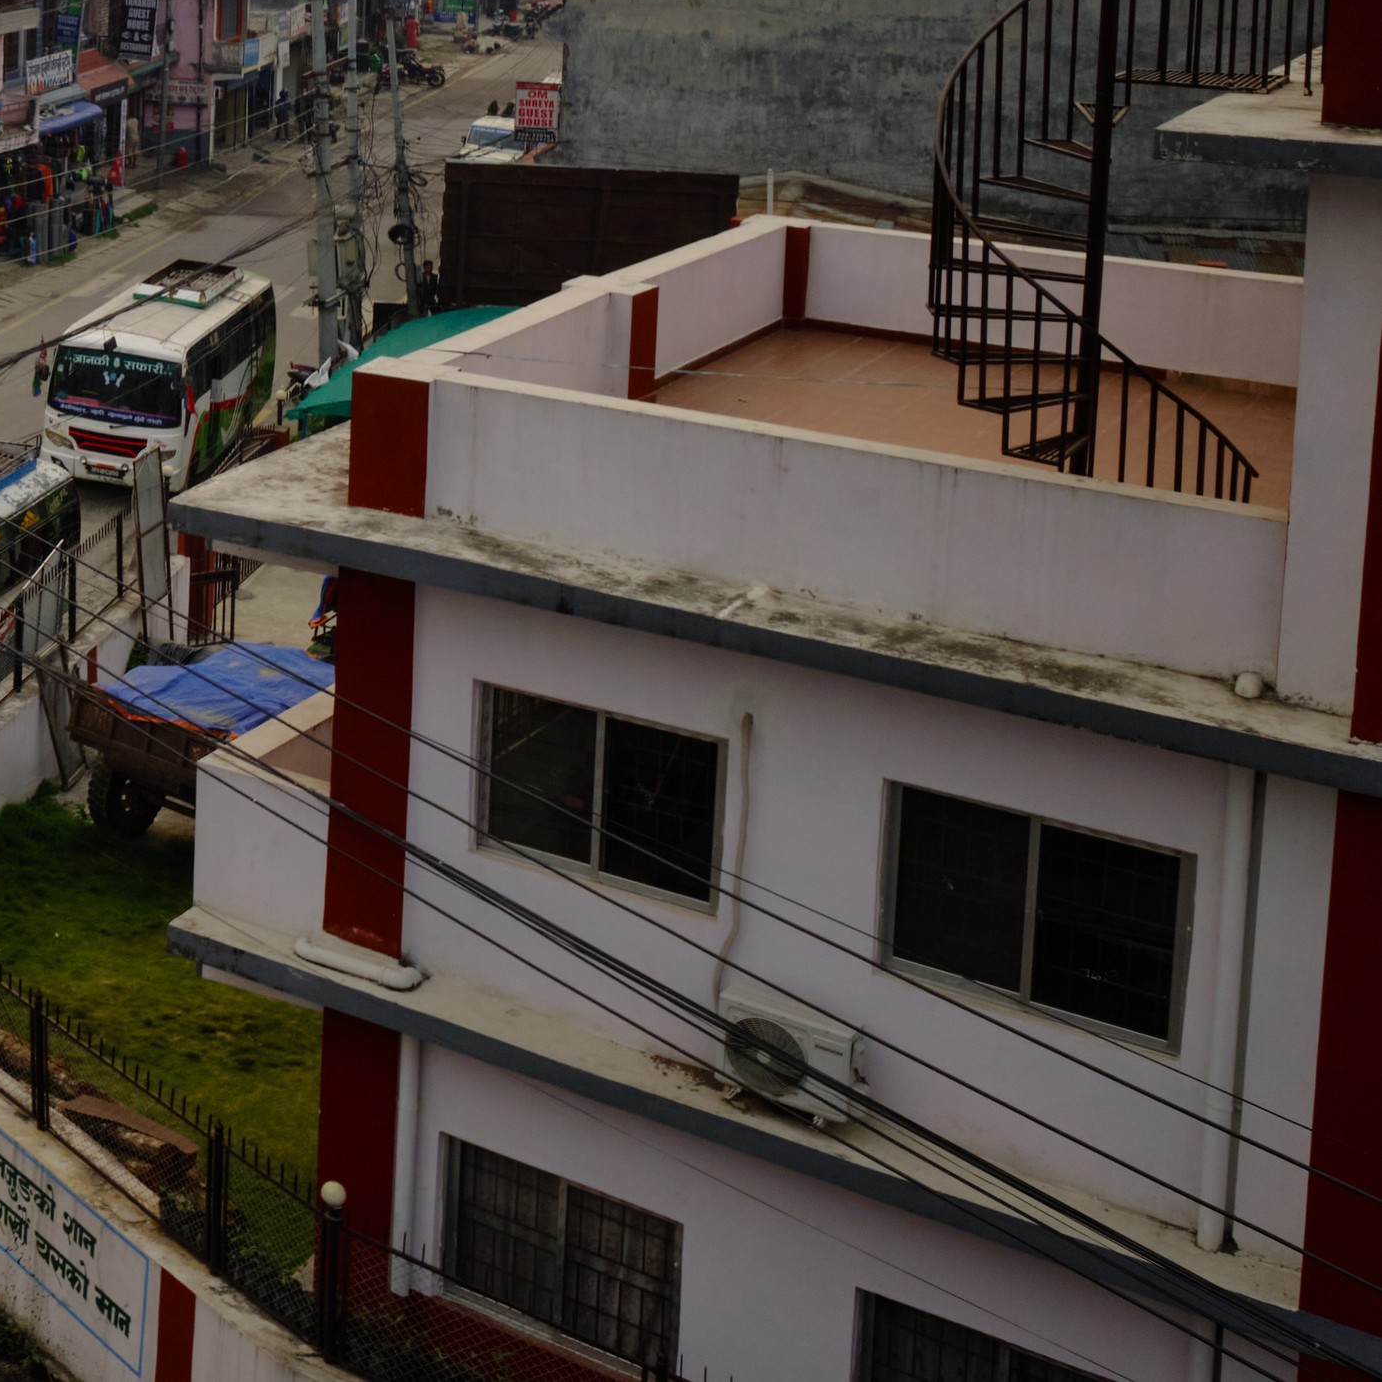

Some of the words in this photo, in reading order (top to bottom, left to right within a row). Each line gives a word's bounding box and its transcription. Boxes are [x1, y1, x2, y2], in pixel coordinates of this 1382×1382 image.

[128, 8, 151, 19] GUEST
[126, 19, 150, 31] HOUSE
[528, 91, 548, 99] OM
[518, 99, 554, 108] SHREYA
[518, 108, 554, 118] GUEST
[518, 118, 553, 127] HOUSE
[72, 353, 110, 367] जानकी
[124, 360, 164, 375] सफारी
[62, 1211, 98, 1260] शान
[34, 1230, 90, 1302] यसको
[94, 1284, 132, 1340] मान
